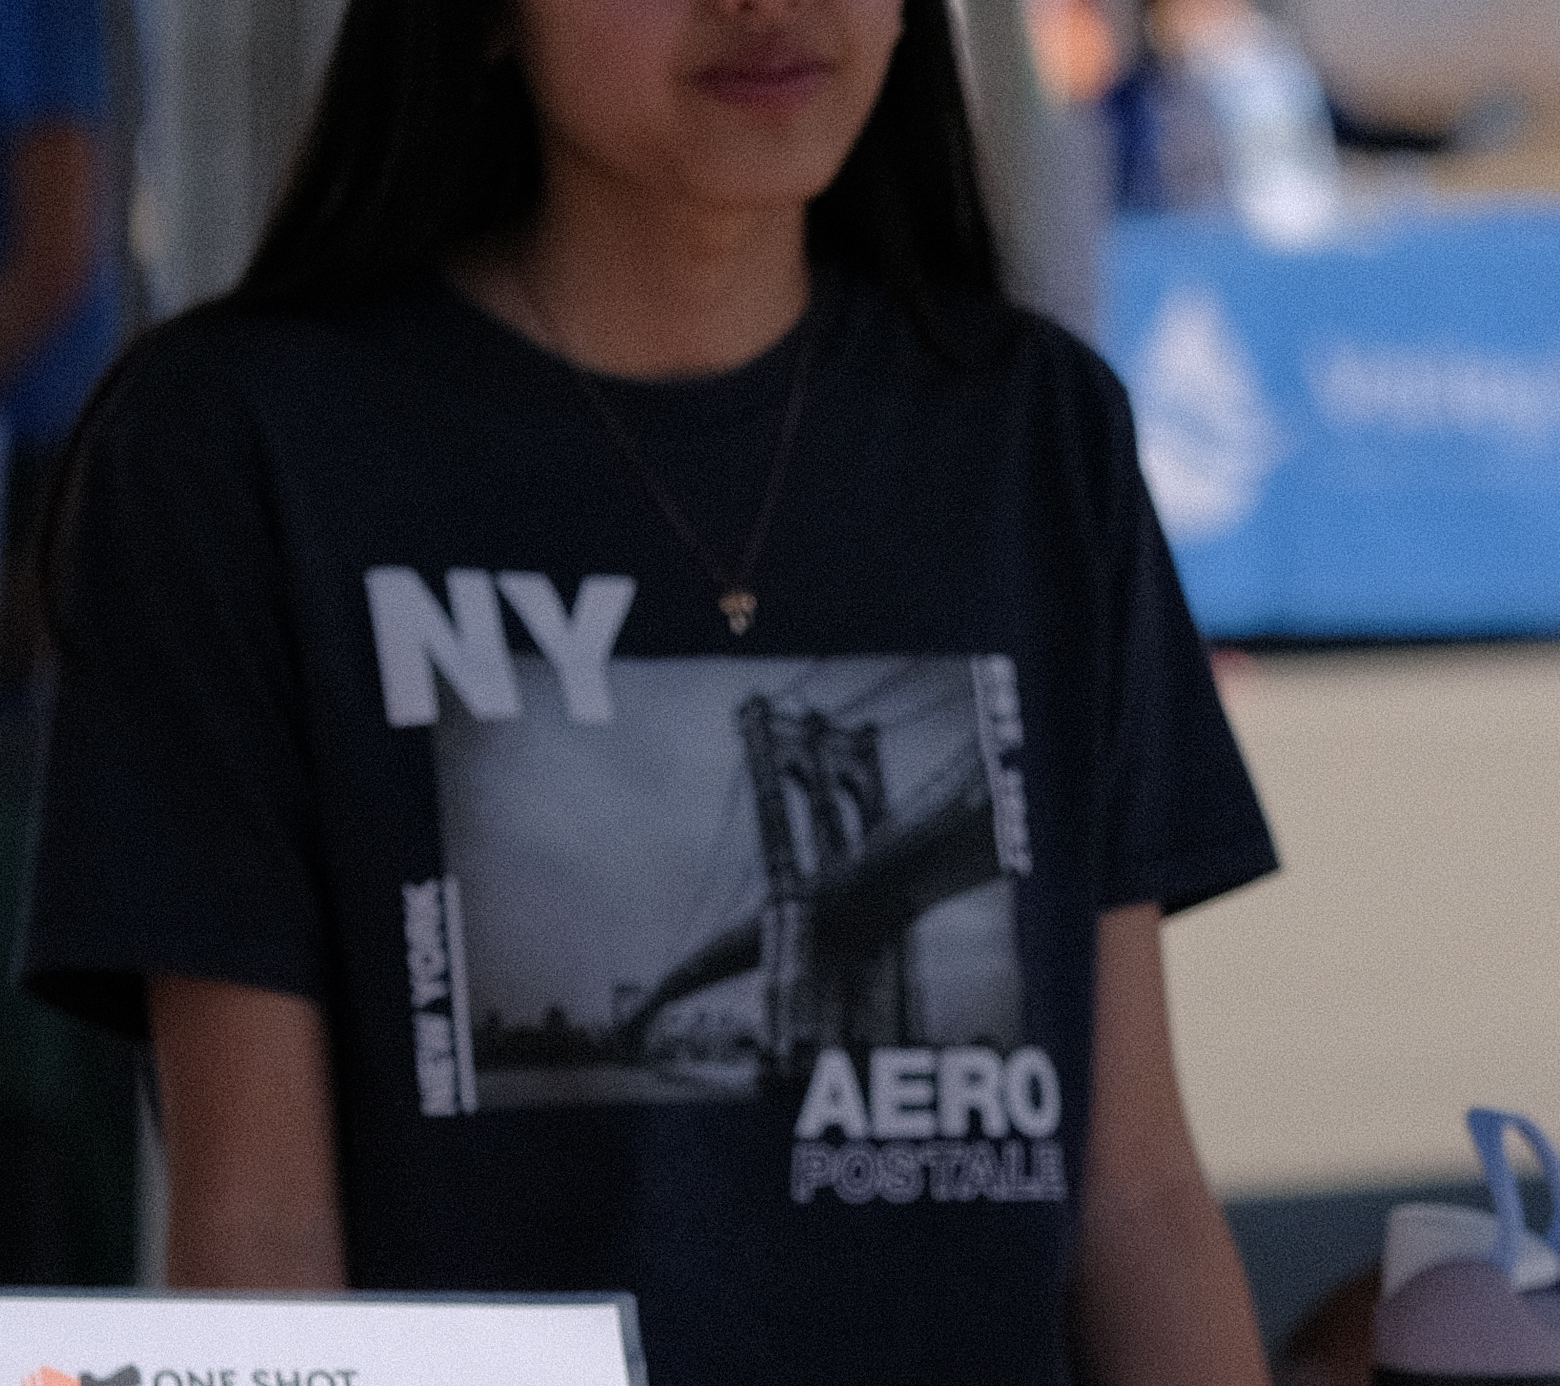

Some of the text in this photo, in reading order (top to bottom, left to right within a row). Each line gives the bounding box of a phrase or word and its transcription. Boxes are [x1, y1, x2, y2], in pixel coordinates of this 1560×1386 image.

[364, 565, 637, 728] NY
[403, 881, 458, 1116] NEW YORK
[795, 1045, 1064, 1140] AERO
[790, 1139, 1068, 1204] POSTALE
